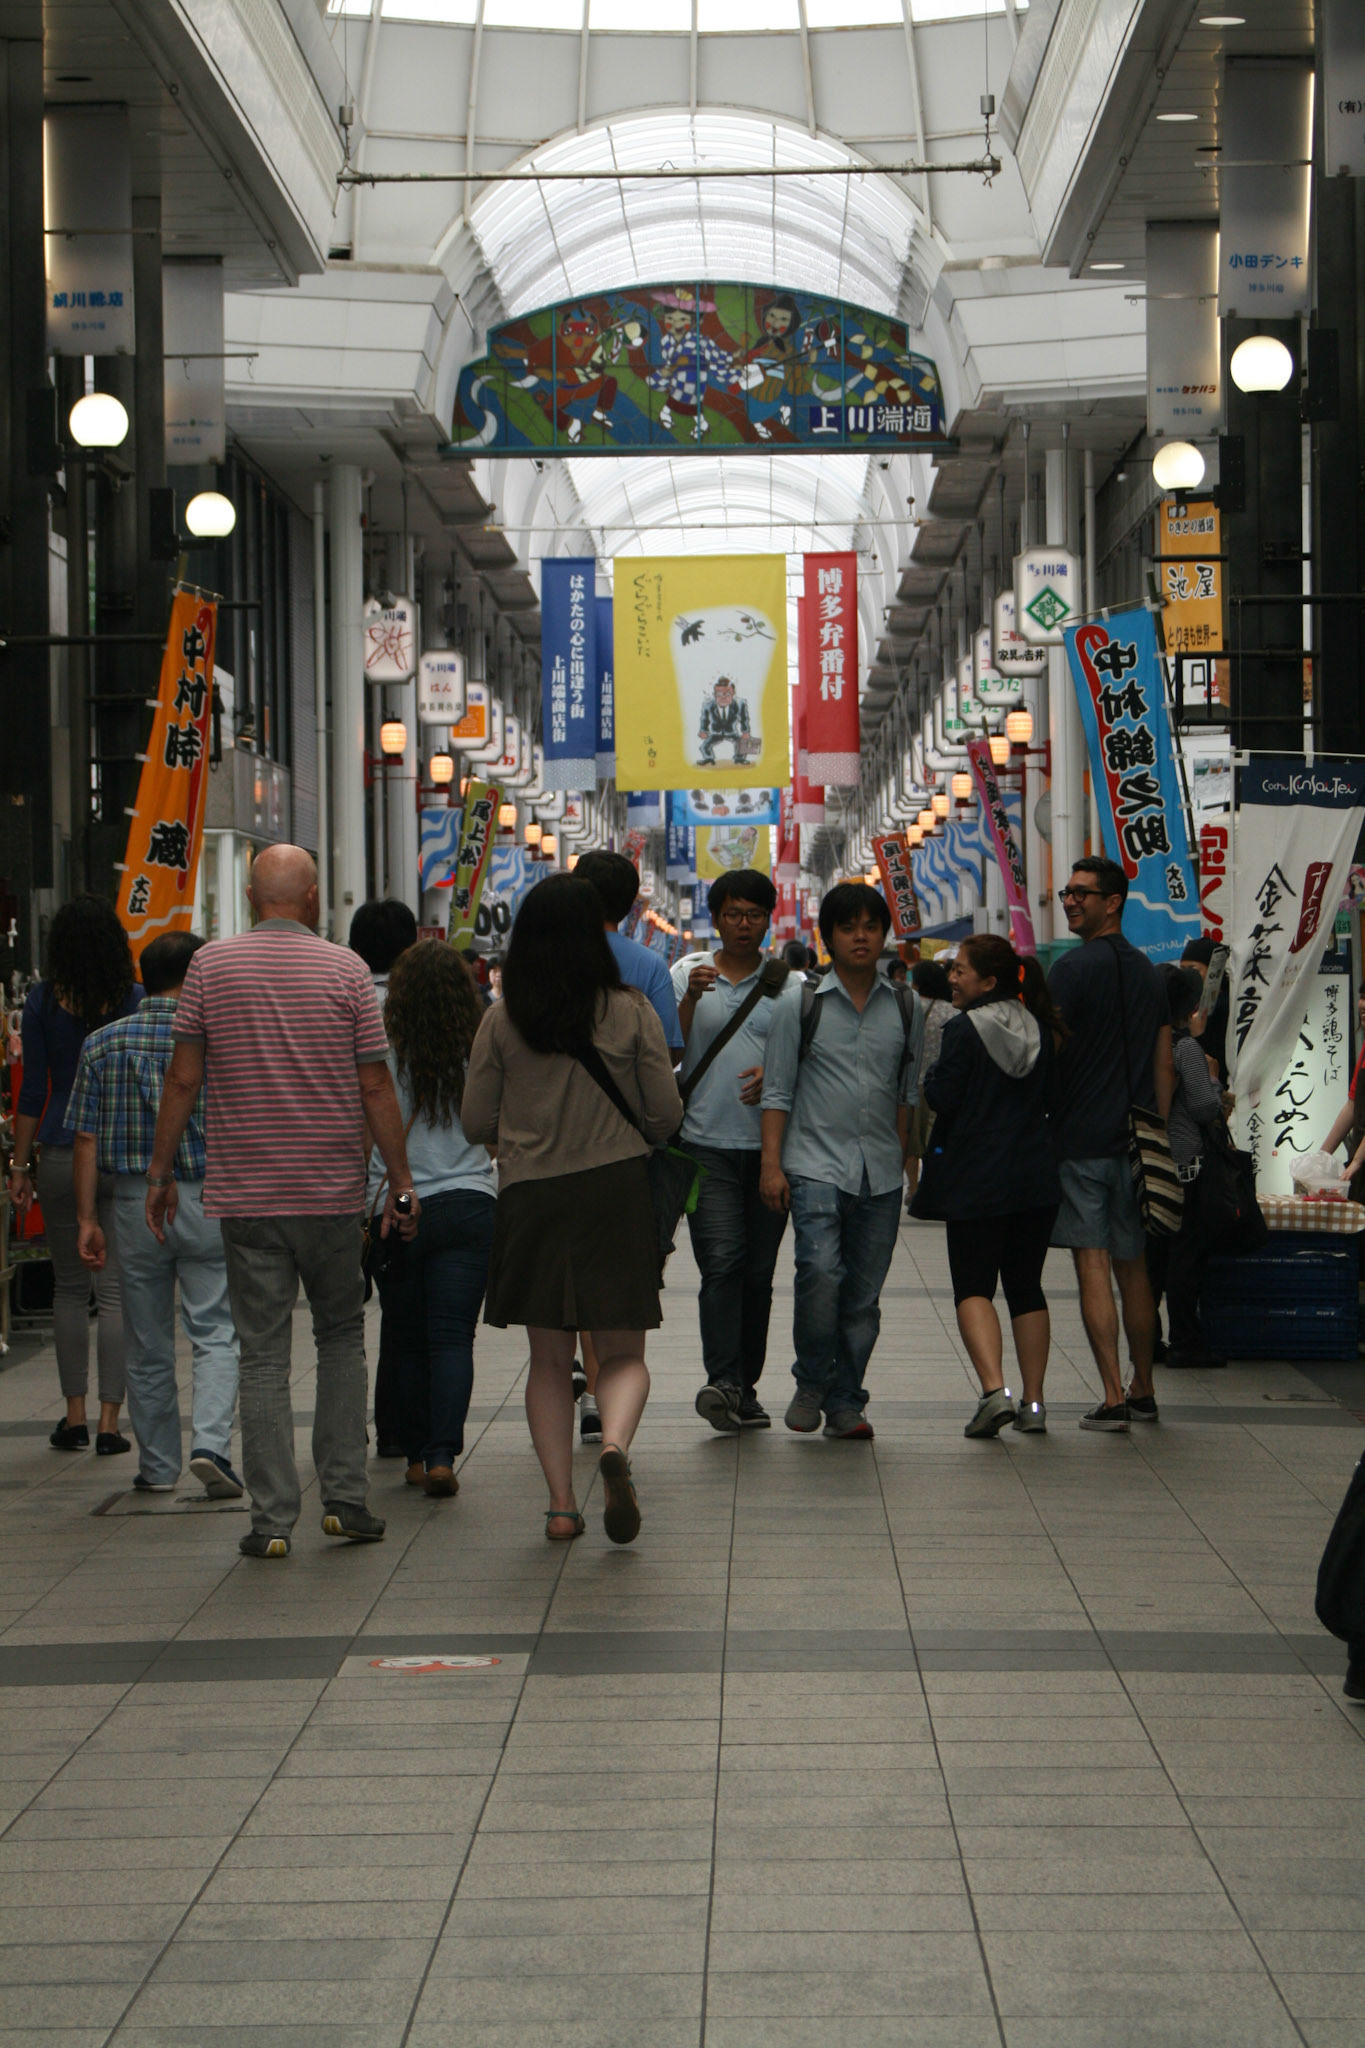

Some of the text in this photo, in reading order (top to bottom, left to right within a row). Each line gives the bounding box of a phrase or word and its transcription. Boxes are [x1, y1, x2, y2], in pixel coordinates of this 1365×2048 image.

[1229, 254, 1304, 269] 小田デンキ
[812, 405, 932, 433] 上川端通
[1027, 563, 1068, 576] 博多川端
[1168, 565, 1216, 599] 池屋
[570, 575, 585, 719] はかたの心に出逢う街
[817, 568, 846, 701] 博多弁番付
[552, 655, 566, 743] 上川端商店街
[601, 671, 613, 740] 上川端商店街
